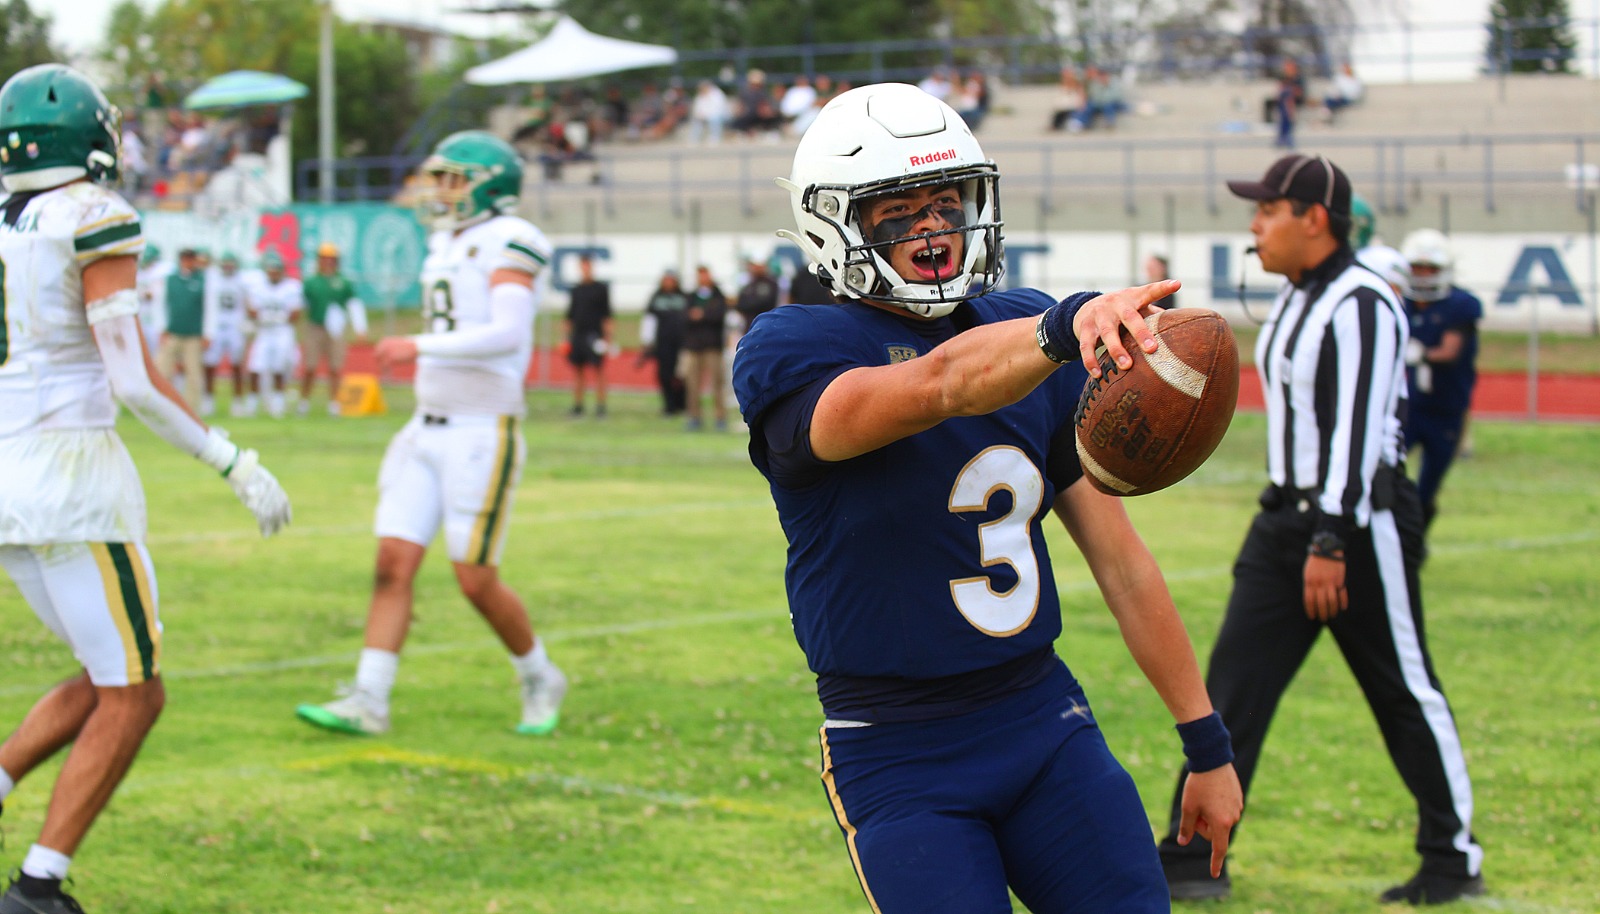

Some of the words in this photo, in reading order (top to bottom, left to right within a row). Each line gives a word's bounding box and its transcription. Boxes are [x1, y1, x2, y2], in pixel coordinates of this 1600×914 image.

[909, 149, 956, 167] Riddell
[1090, 388, 1140, 449] Wilson
[948, 444, 1045, 638] 3
